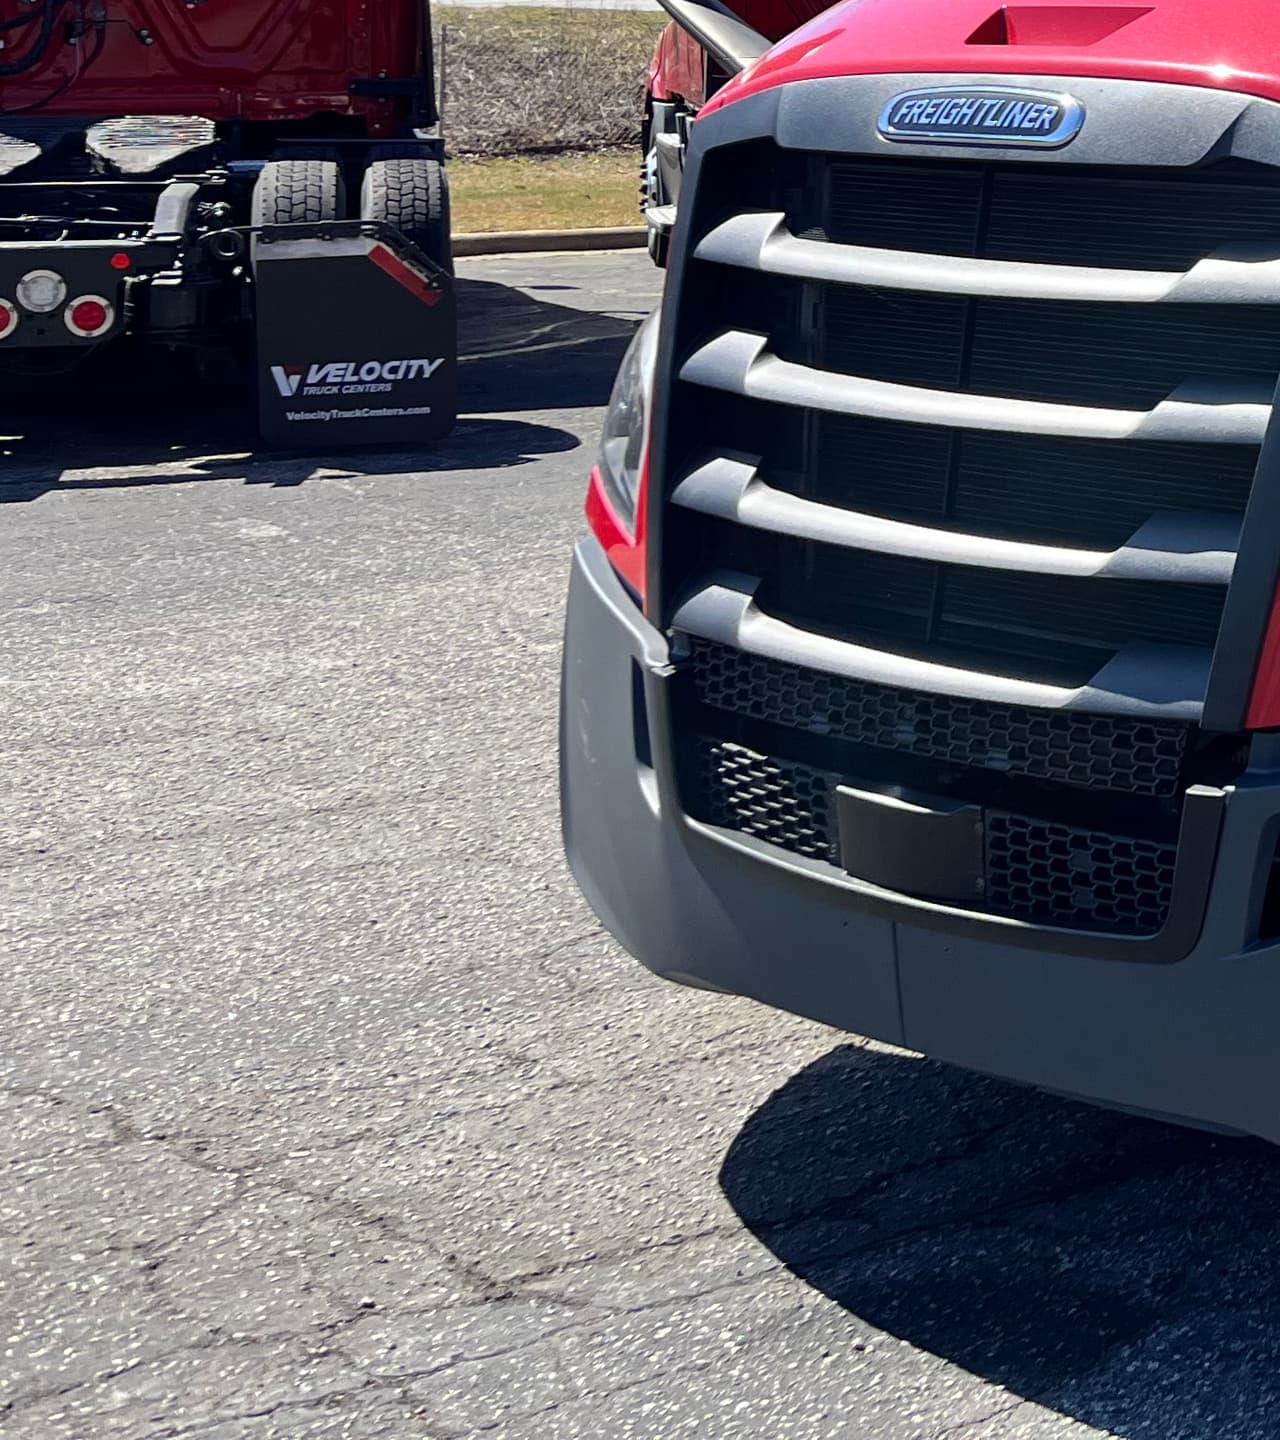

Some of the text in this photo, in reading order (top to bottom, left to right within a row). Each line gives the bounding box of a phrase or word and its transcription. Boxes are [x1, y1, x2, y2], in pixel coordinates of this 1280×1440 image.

[893, 97, 1060, 130] FREIGHTLINER
[306, 358, 446, 384] VELOCITY
[303, 382, 393, 396] TRUCK CENTERS
[285, 406, 432, 421] VelocityTruckCenters.com
